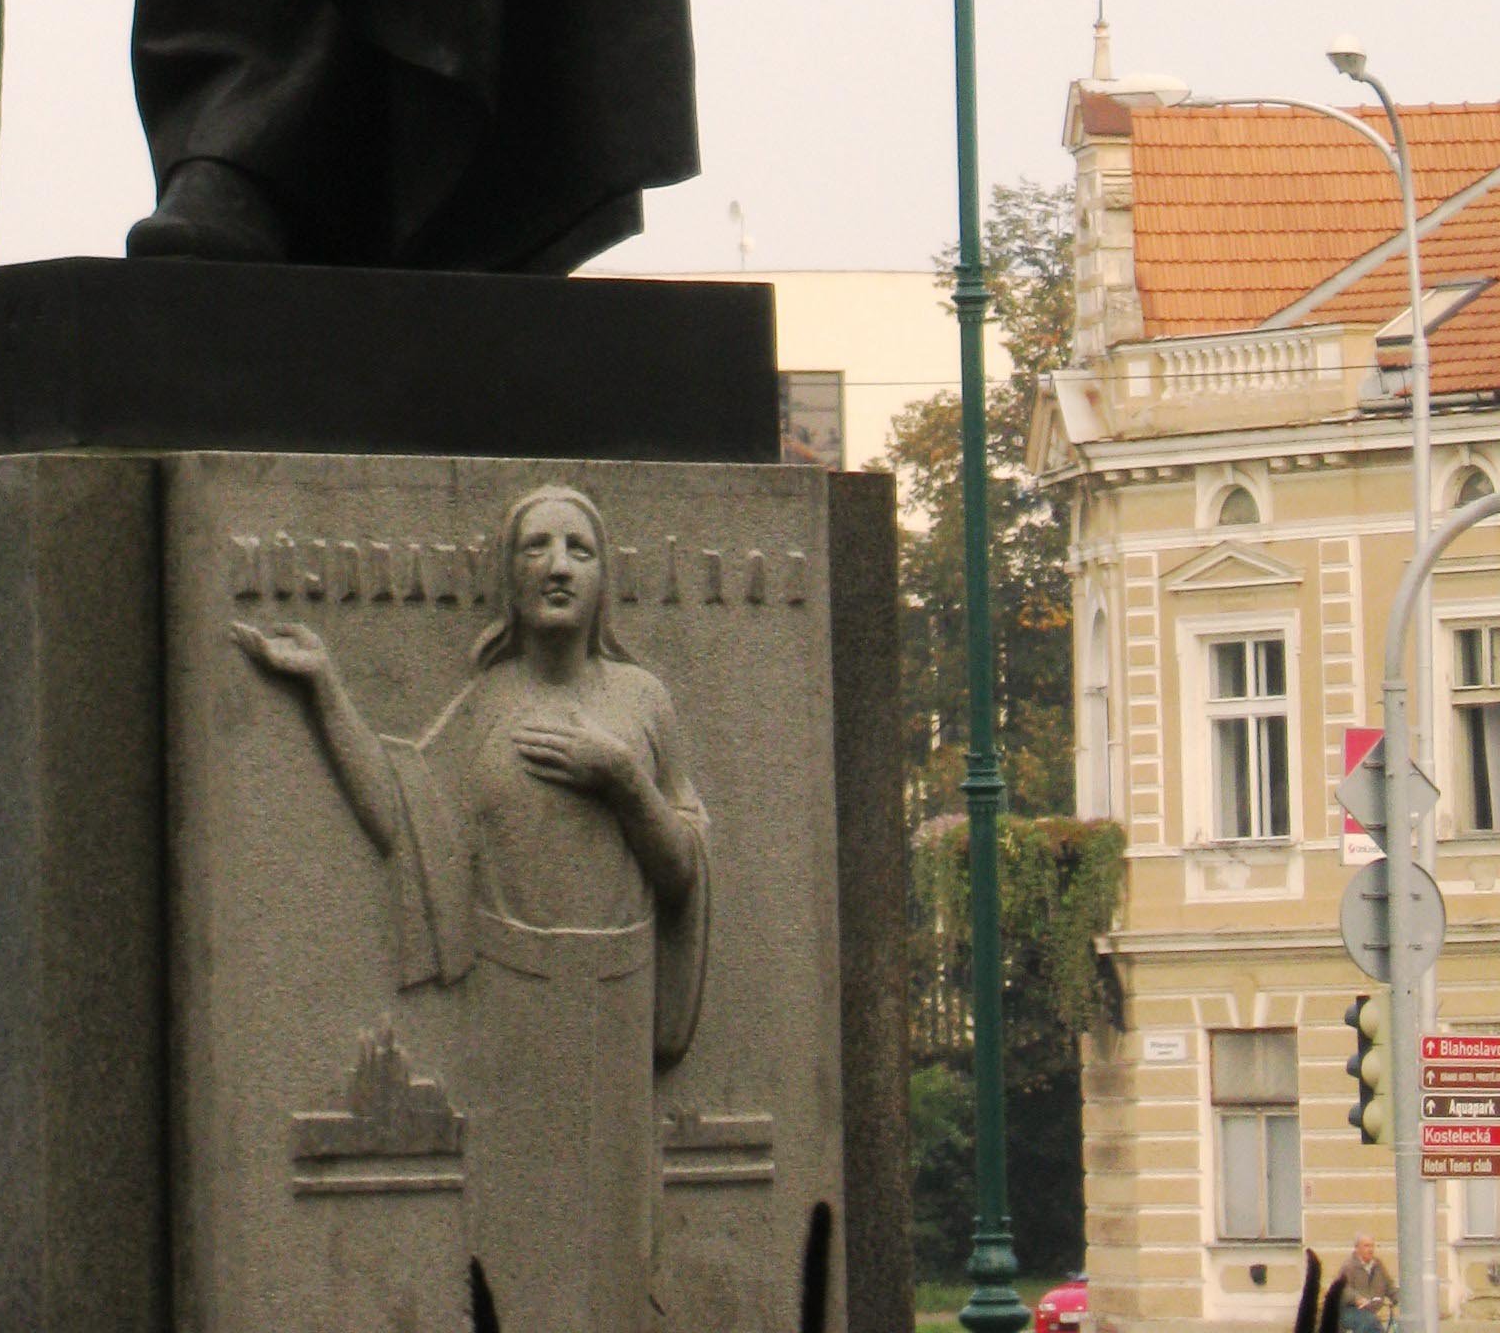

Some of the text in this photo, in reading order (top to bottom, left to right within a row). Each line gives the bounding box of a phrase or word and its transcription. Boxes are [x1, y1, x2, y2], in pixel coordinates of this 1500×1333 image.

[1448, 1099, 1495, 1117] Aquapark
[1425, 1128, 1491, 1143] Kostelecká
[1424, 1158, 1492, 1173] Hotel Tenis club
